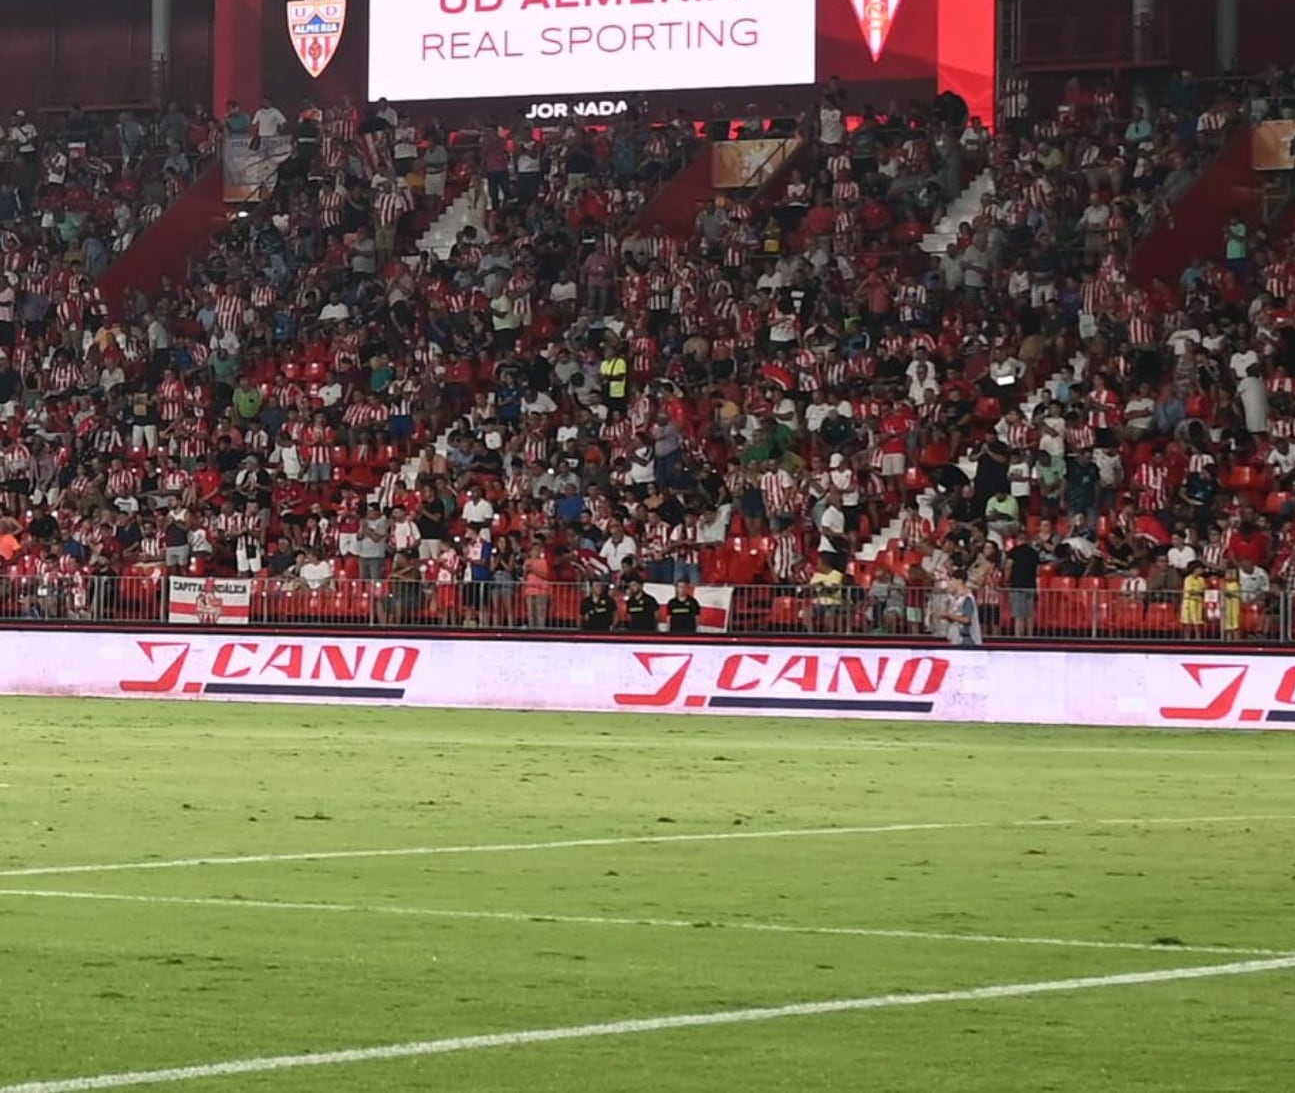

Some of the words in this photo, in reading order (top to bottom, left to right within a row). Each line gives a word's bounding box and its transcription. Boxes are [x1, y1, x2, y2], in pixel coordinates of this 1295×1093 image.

[422, 30, 523, 60] REAL
[541, 18, 758, 56] SPORTING
[525, 100, 628, 119] JORNADA
[211, 643, 421, 682] CANO
[716, 654, 950, 695] CANO
